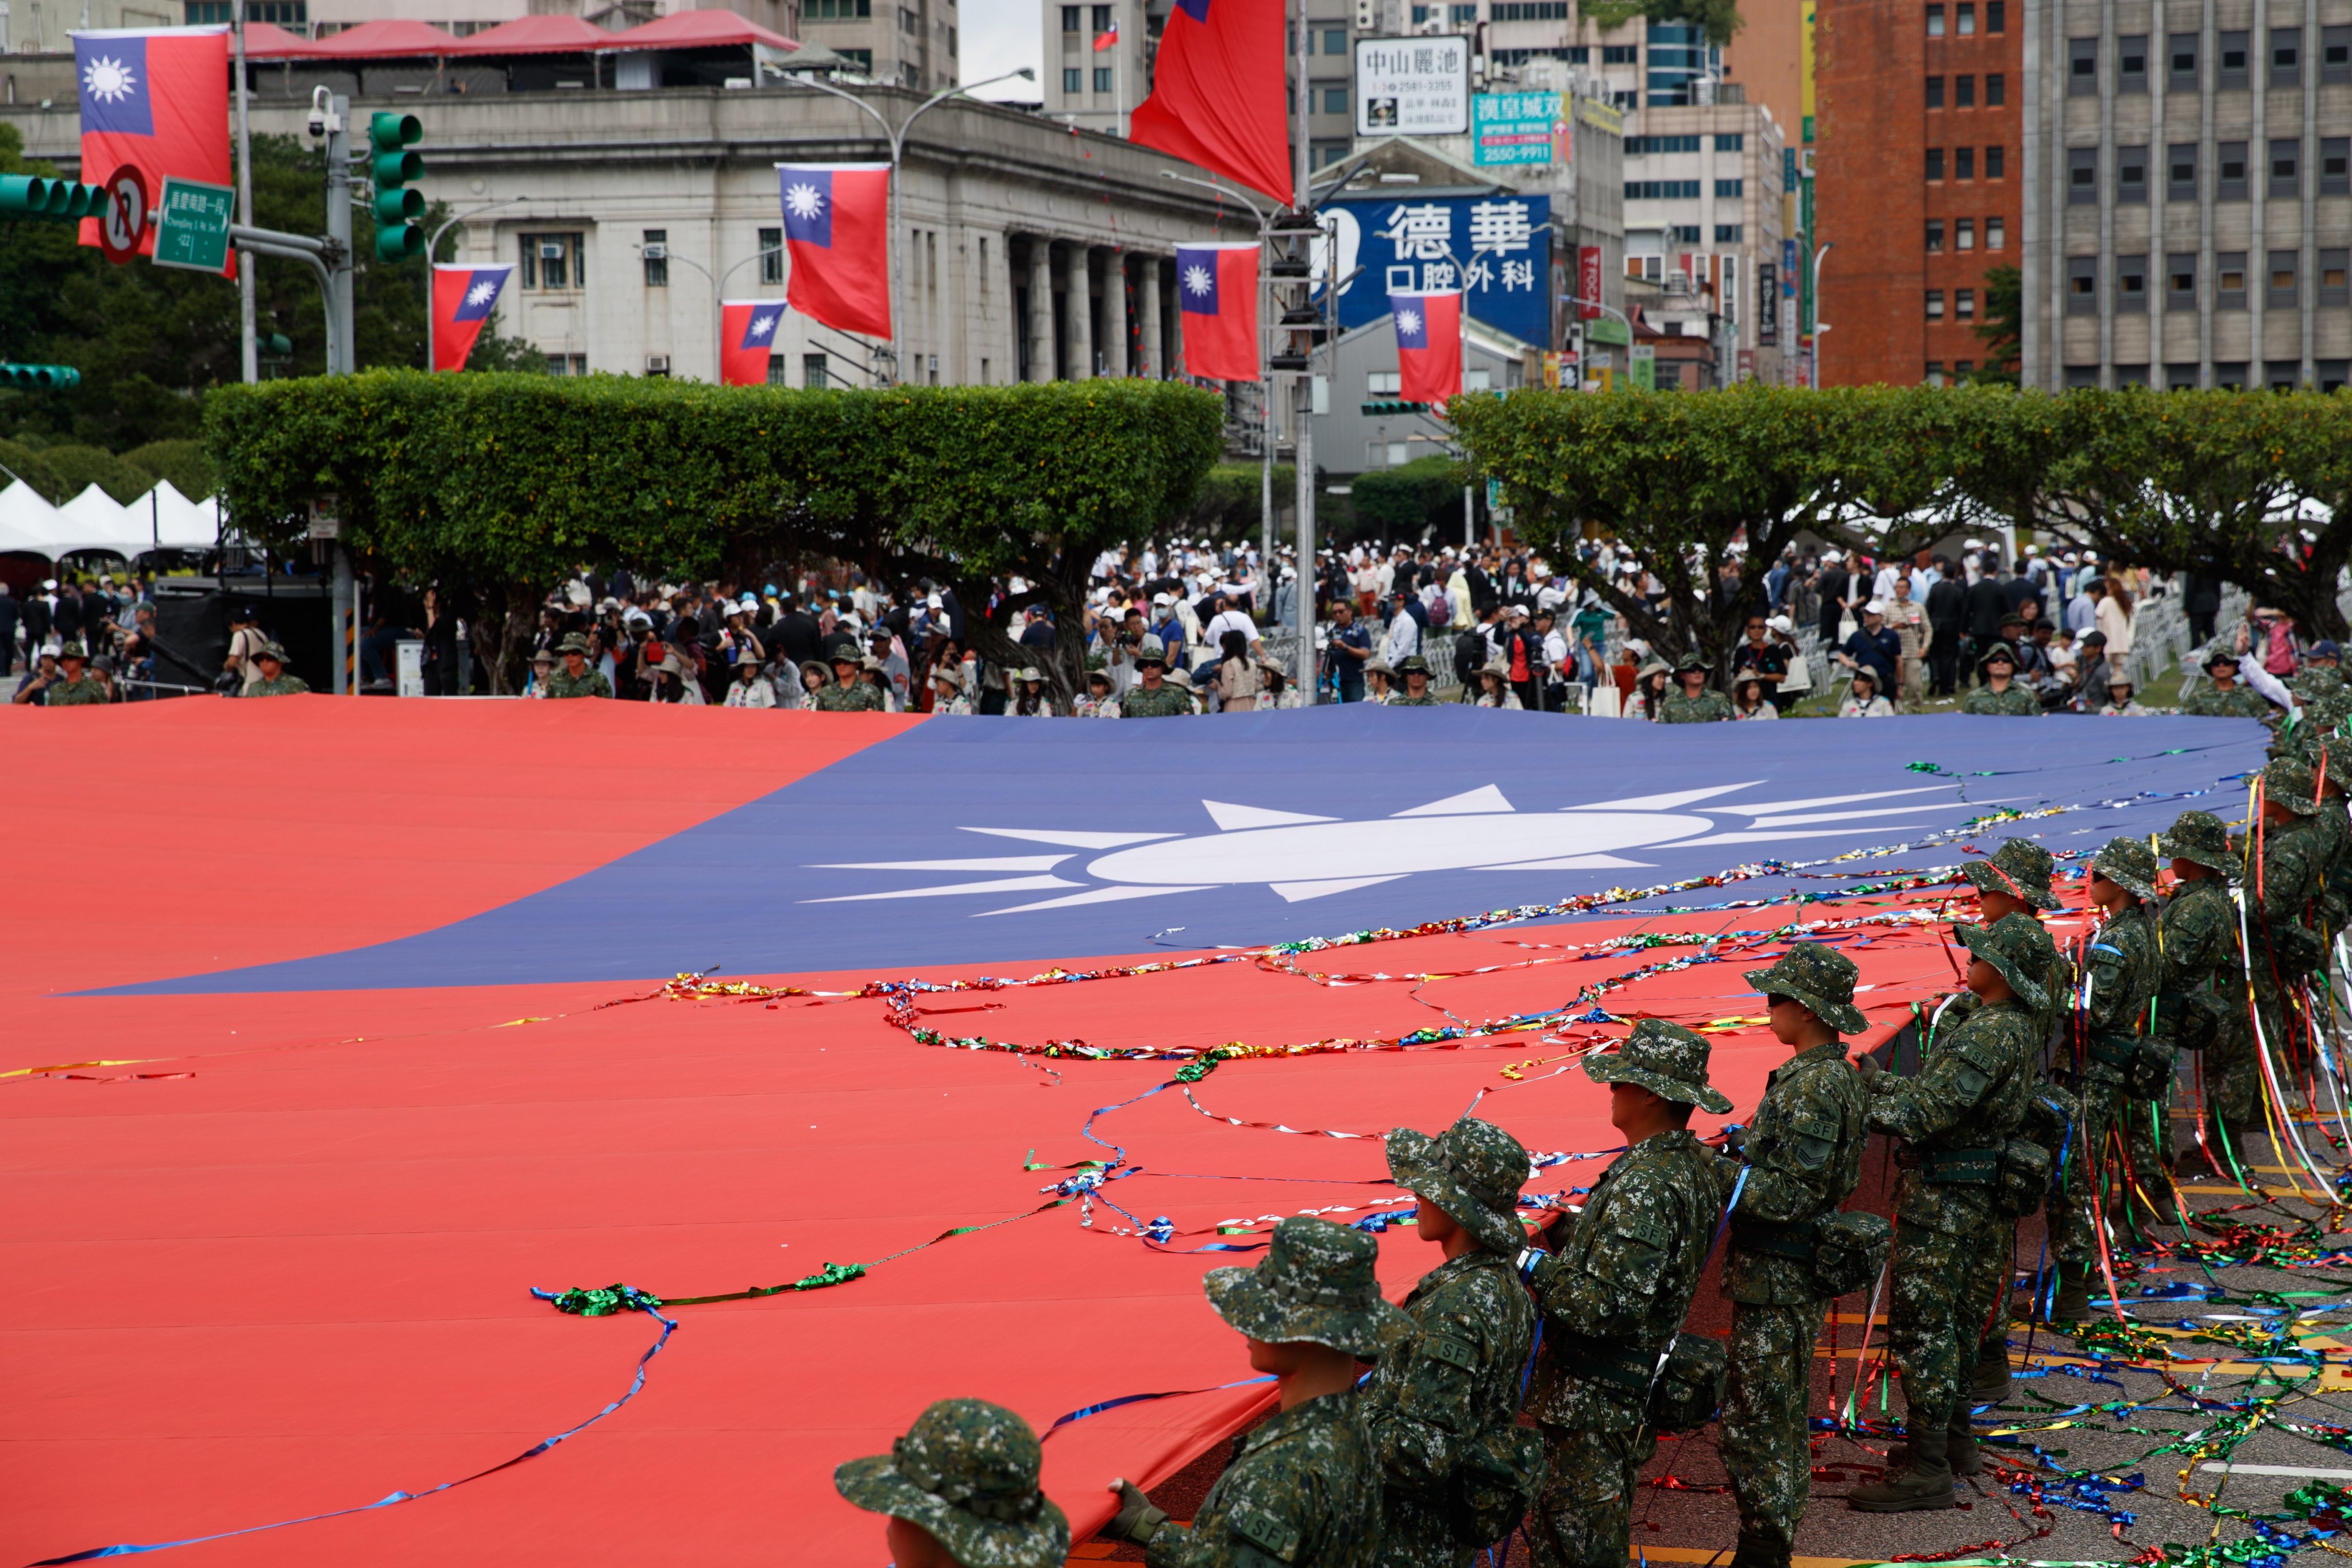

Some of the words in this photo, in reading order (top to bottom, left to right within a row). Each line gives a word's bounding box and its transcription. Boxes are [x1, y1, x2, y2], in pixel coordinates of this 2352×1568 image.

[1366, 47, 1458, 76] 中山麗池
[1478, 96, 1565, 121] 漢皇城双
[1484, 146, 1548, 162] 2550-9911
[171, 191, 225, 215] 重慶南路一段
[1387, 200, 1532, 260] 德華
[1386, 259, 1535, 293] 口腔外科
[2100, 951, 2115, 961] SF
[1973, 1051, 1989, 1064] SF
[1813, 1122, 1830, 1136] SF
[1639, 1224, 1659, 1241] SF
[1443, 1343, 1466, 1361] SF
[1253, 1519, 1281, 1542] SF
